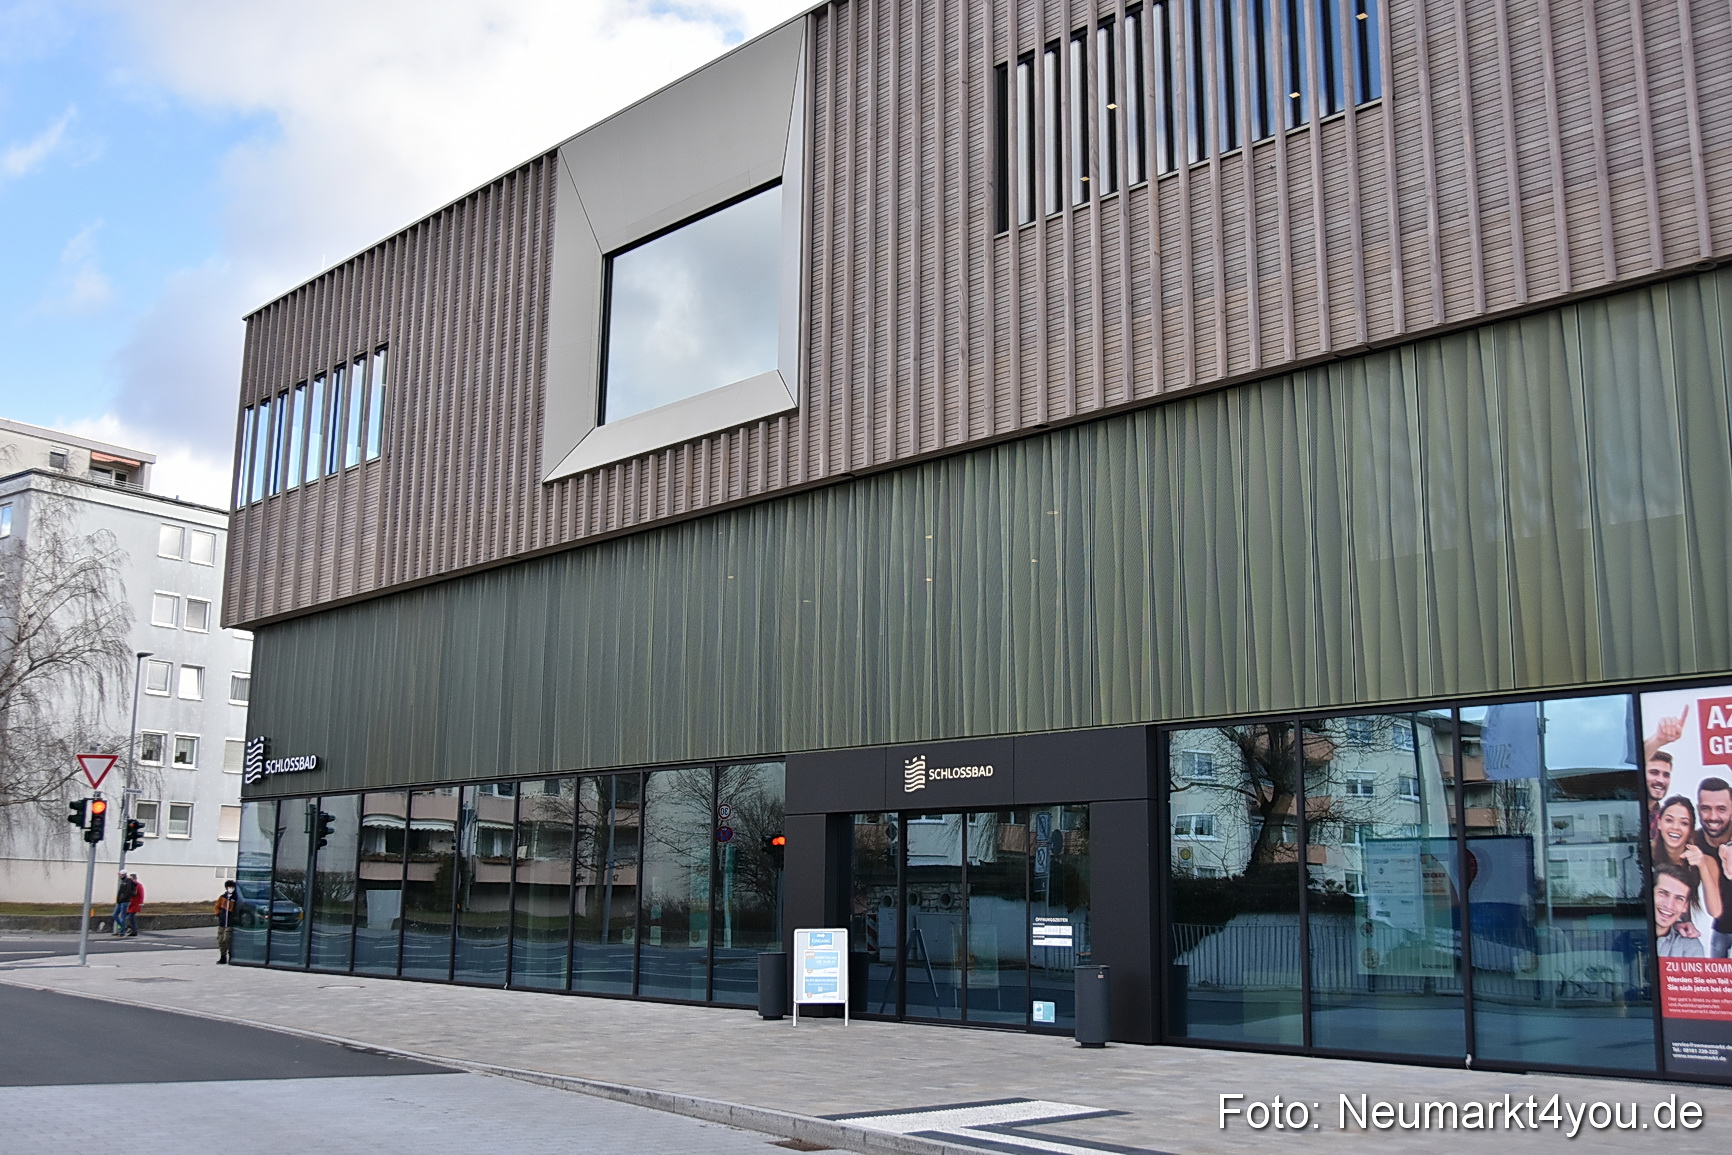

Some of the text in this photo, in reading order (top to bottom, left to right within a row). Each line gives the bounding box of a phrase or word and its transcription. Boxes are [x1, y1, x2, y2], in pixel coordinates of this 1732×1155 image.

[265, 755, 317, 775] SCHLOSSBAD
[928, 765, 994, 780] SCHLOSSBAD
[1665, 961, 1679, 972] ZU
[1681, 962, 1703, 972] UNS
[1666, 976, 1693, 984] Werden
[1693, 976, 1705, 984] Sie
[1667, 983, 1679, 991] Sie
[1679, 984, 1693, 992] sich
[1693, 985, 1710, 993] jetzt
[1710, 985, 1722, 993] bei
